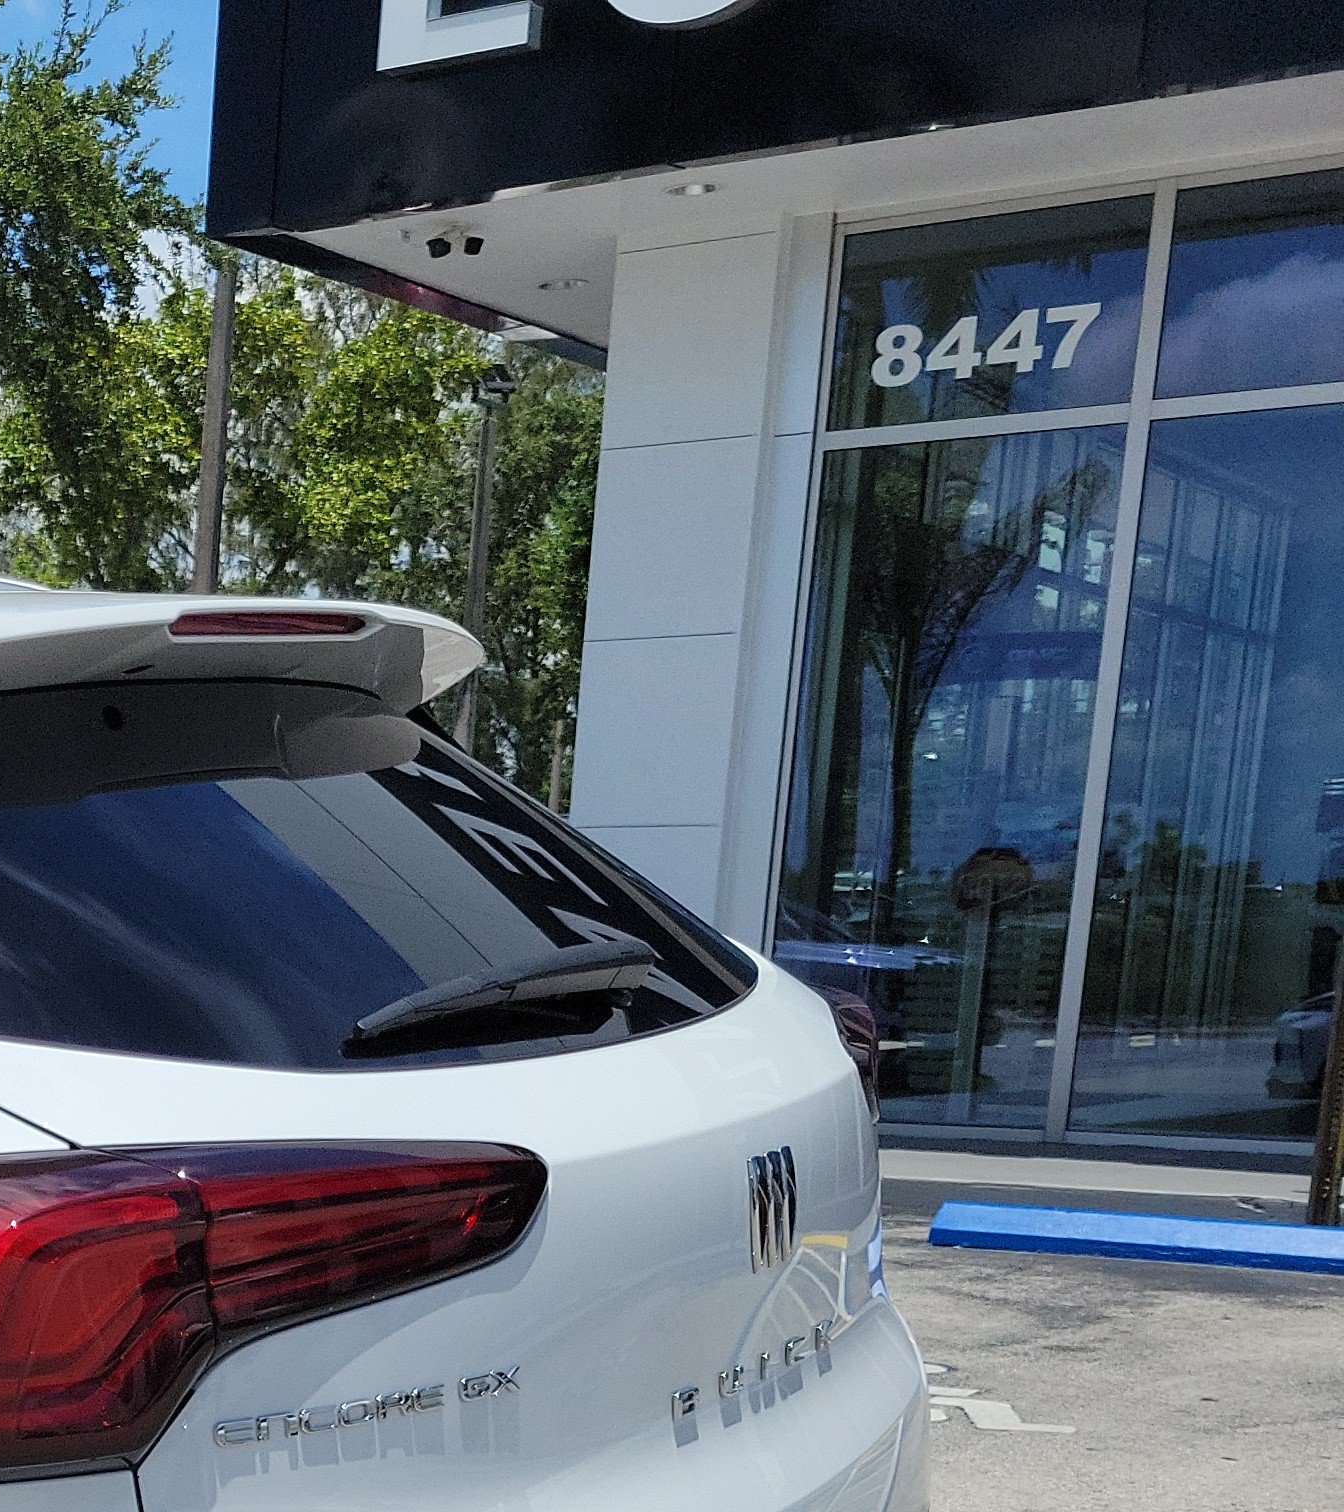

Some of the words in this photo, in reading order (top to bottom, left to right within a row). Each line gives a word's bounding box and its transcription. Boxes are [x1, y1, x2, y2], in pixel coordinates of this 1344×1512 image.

[870, 302, 1103, 389] 8447
[213, 1383, 445, 1447] ENCORE
[458, 1365, 521, 1402] GX
[671, 1319, 833, 1423] BUICK
